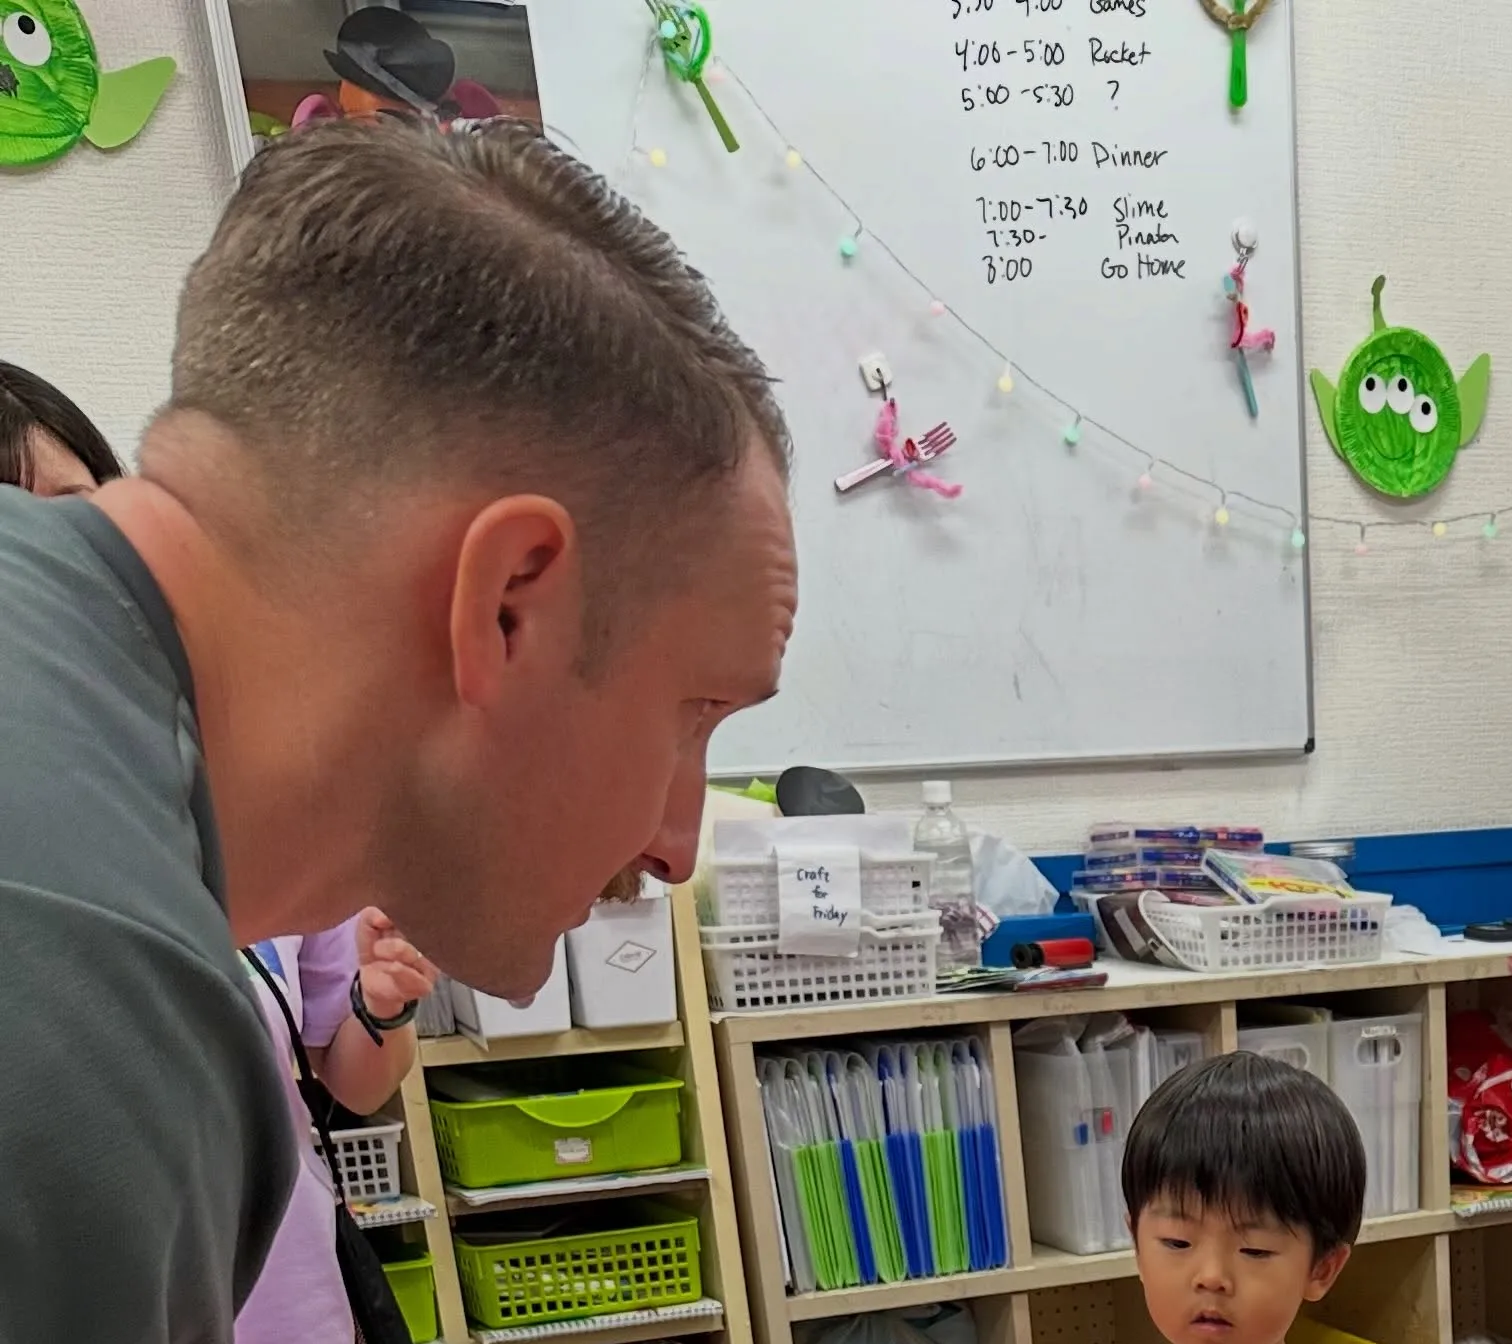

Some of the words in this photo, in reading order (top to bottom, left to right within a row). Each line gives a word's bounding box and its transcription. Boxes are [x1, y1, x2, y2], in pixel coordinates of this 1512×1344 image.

[1089, 37, 1151, 66] Rocket
[1107, 81, 1120, 111] ?
[1091, 142, 1169, 168] Dinner
[1101, 256, 1128, 279] Go
[1138, 252, 1186, 280] Home
[797, 866, 829, 883] Craft
[813, 904, 848, 927] Friday
